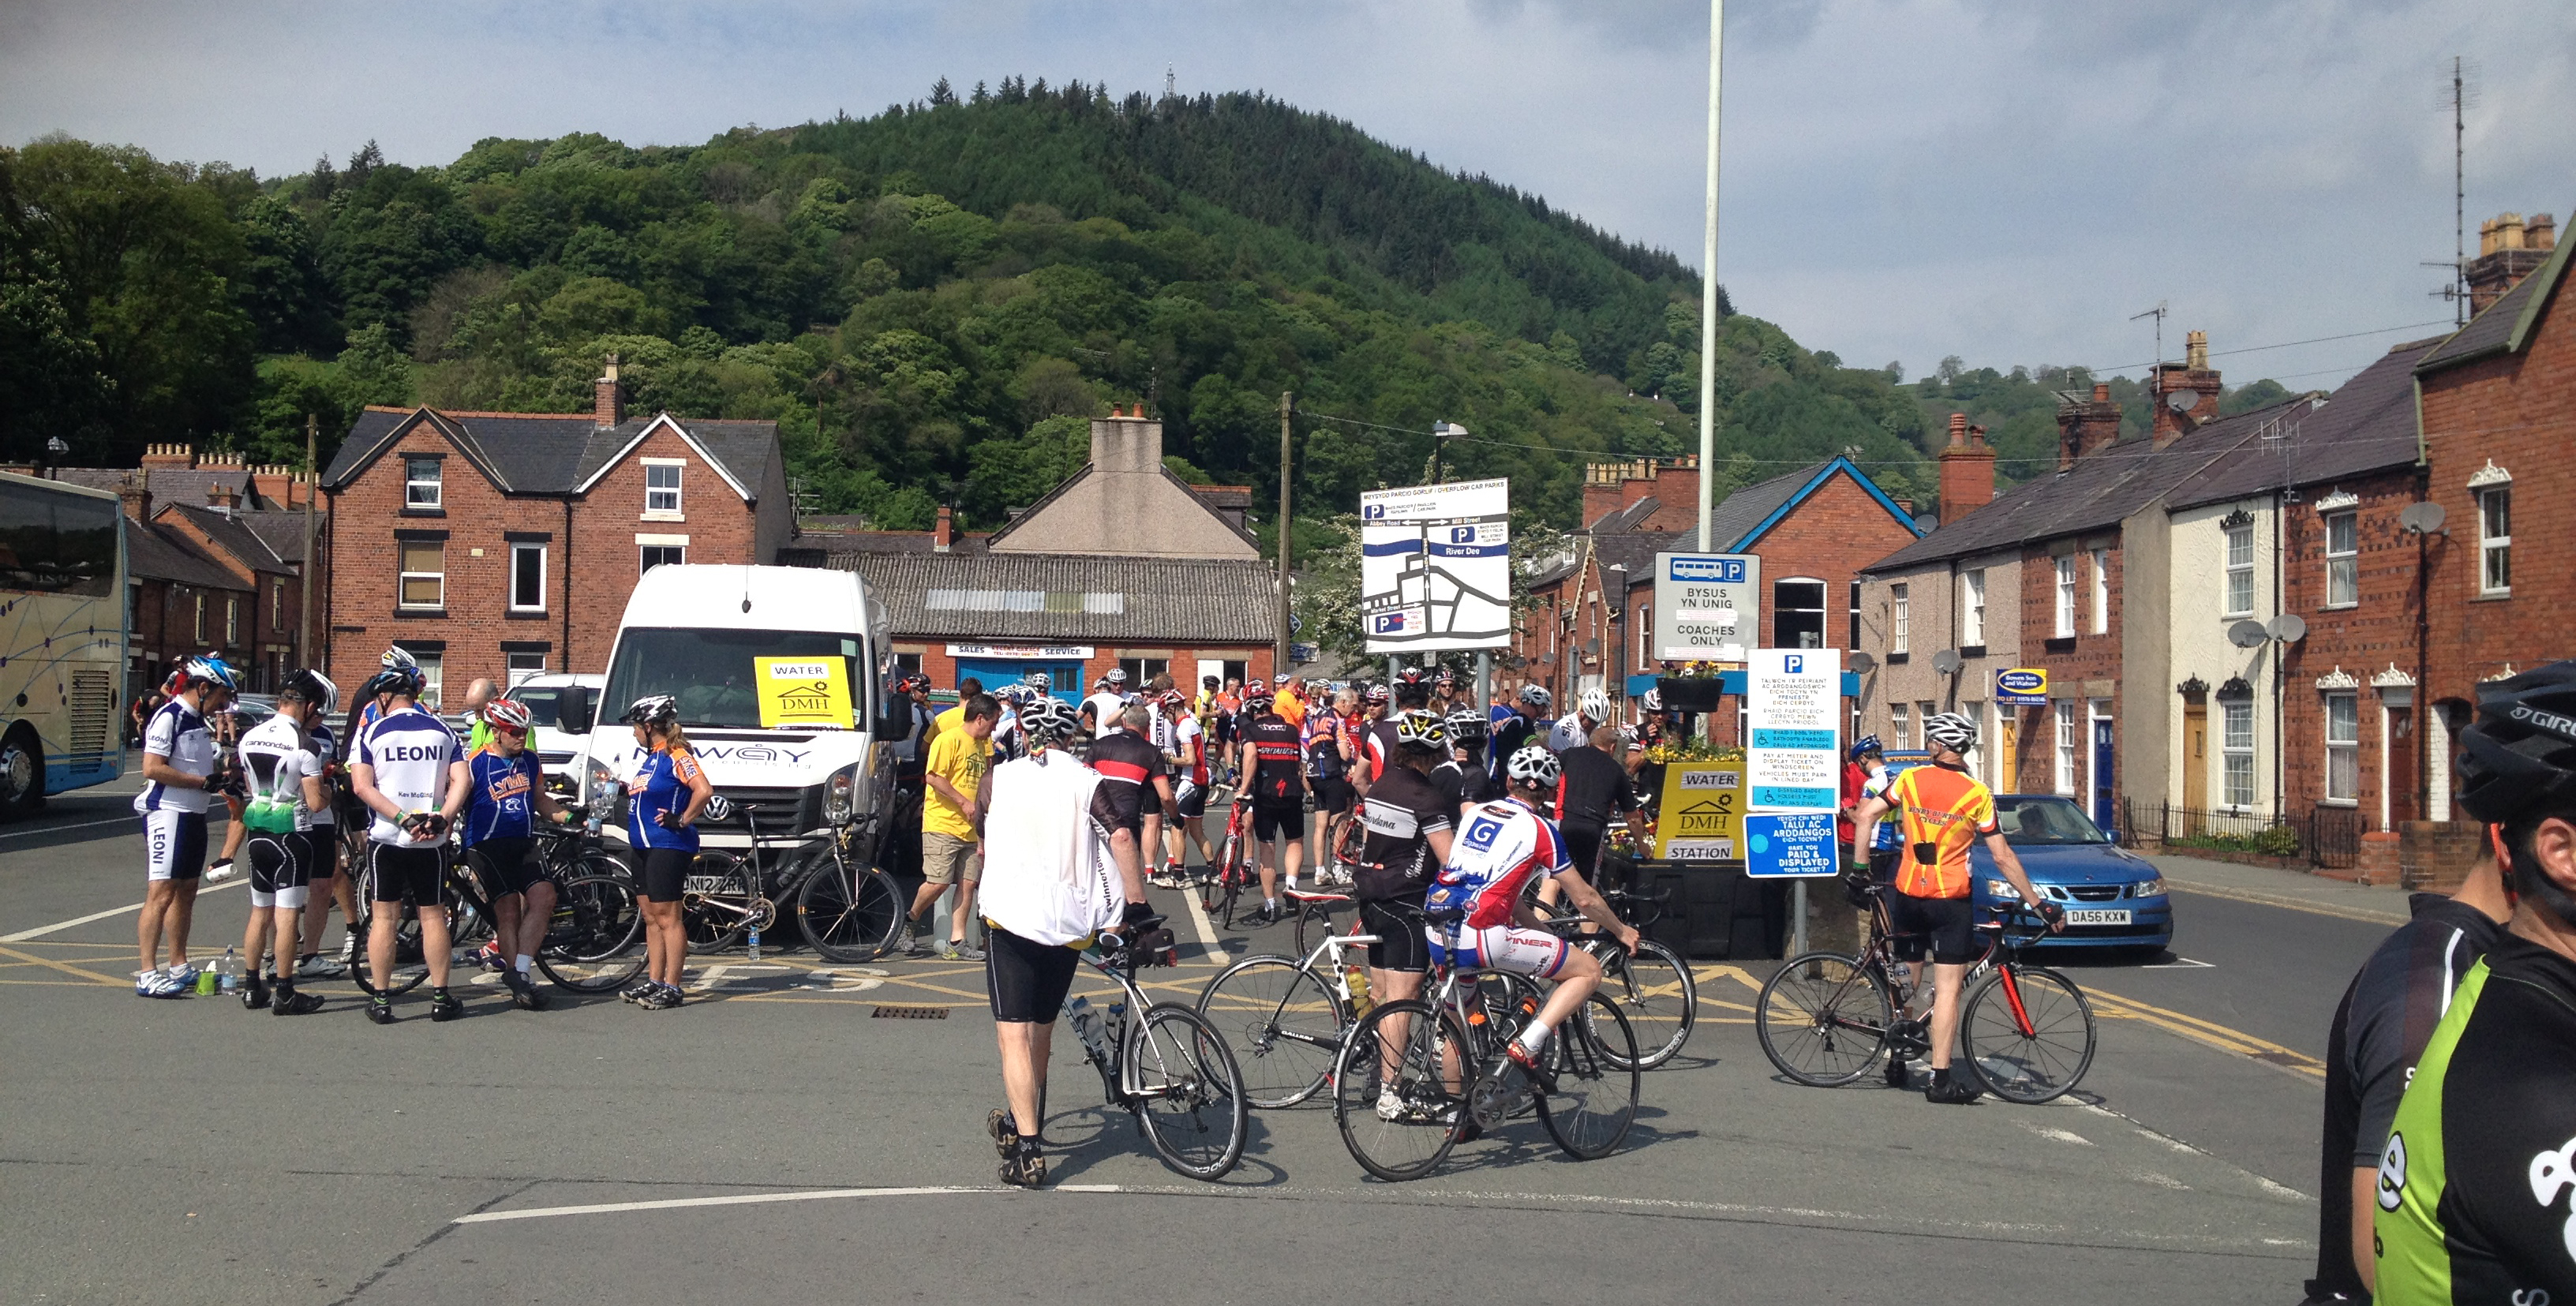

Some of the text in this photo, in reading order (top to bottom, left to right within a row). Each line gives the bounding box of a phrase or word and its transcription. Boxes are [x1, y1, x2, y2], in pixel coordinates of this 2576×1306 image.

[1372, 505, 1380, 518] P
[1458, 529, 1468, 543] P
[1728, 563, 1740, 578] P
[1687, 588, 1727, 598] BYSUS
[1681, 598, 1732, 608] YN UNIG
[1380, 617, 1390, 631] P
[1677, 625, 1735, 636] COACHES
[1690, 636, 1722, 646] ONLY
[1788, 656, 1801, 672] P
[775, 666, 824, 675] WATER
[782, 698, 829, 709] DMH
[1561, 719, 1575, 738] sky
[148, 734, 168, 743] LEONI
[245, 740, 294, 751] cannondale
[385, 745, 444, 762] LEONI
[679, 756, 698, 776] LYME
[1687, 775, 1735, 784] WATER
[488, 773, 530, 799] LYME
[1680, 815, 1727, 829] DMH
[1919, 816, 1948, 826] CYCLES
[1474, 822, 1496, 842] G
[1773, 829, 1832, 837] ARDDANGOS
[152, 827, 166, 864] LEONI
[1672, 848, 1730, 859] STATION
[2072, 911, 2126, 922] DA56 KXW
